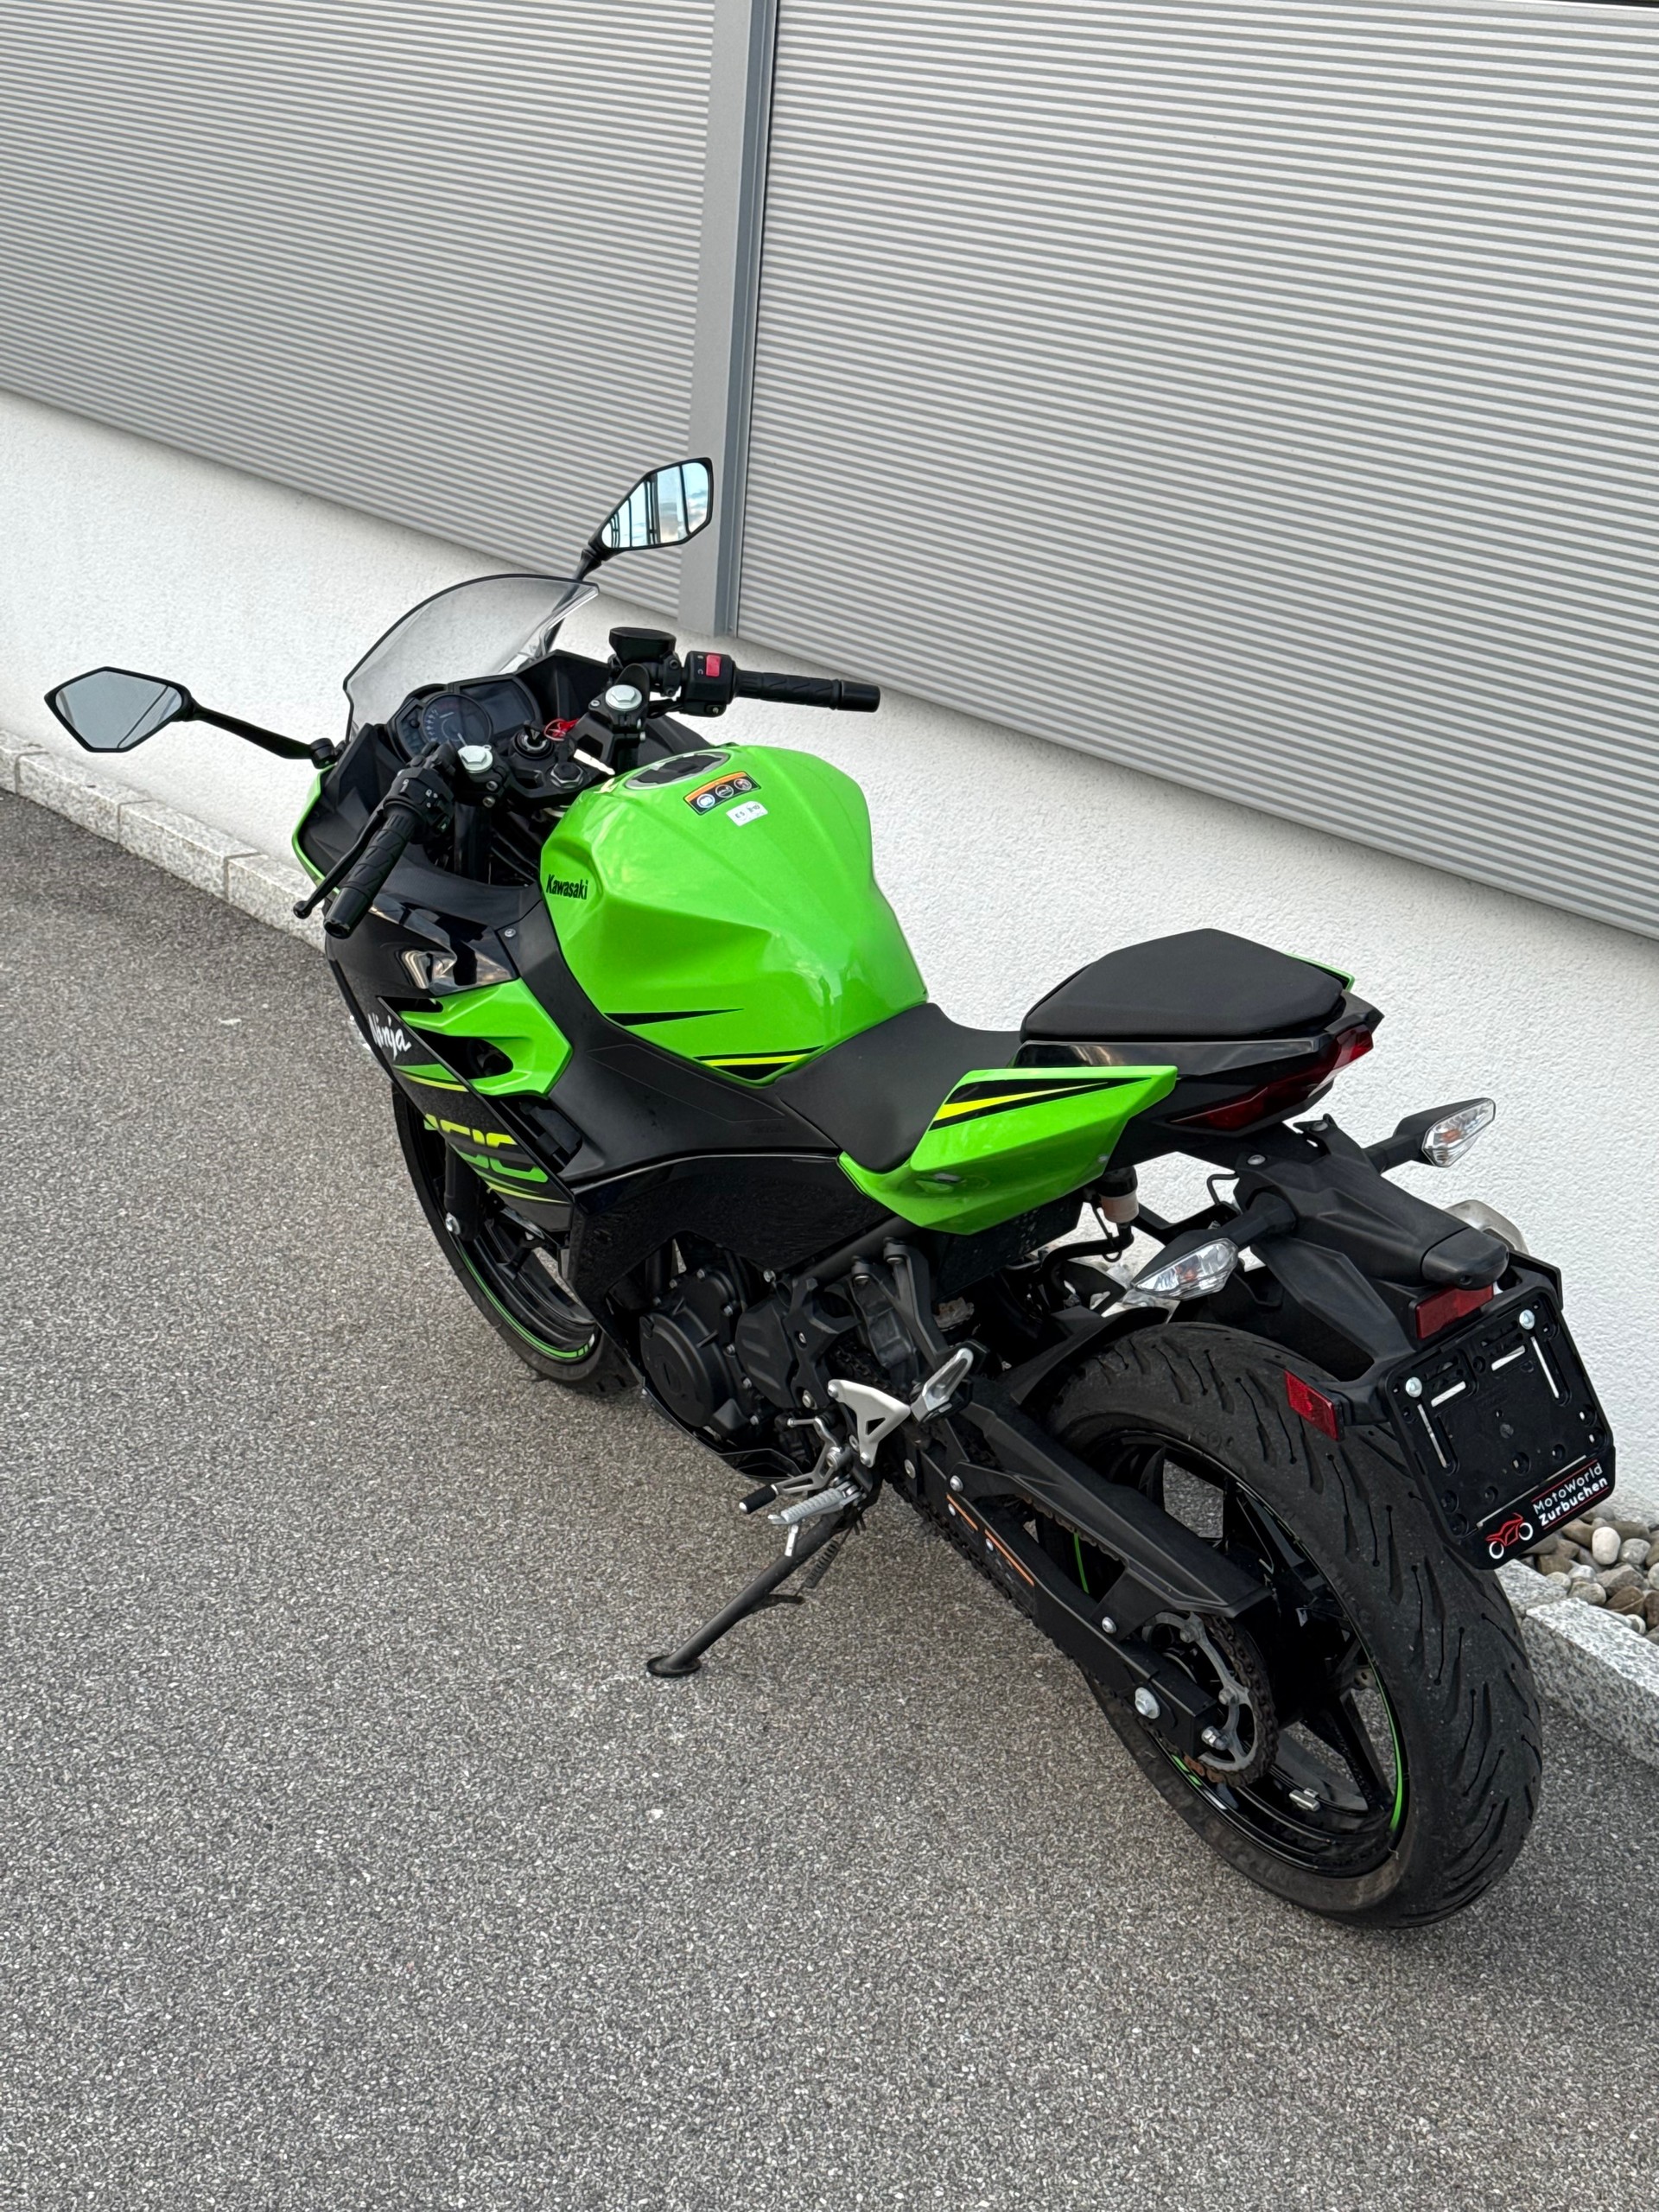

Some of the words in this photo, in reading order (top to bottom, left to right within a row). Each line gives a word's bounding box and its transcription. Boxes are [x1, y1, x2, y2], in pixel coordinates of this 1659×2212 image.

[545, 874, 588, 900] Kawasaki
[367, 1012, 412, 1061] Ninja
[1533, 1462, 1603, 1515] MotoWorld
[1538, 1477, 1608, 1527] Zurbuchen
